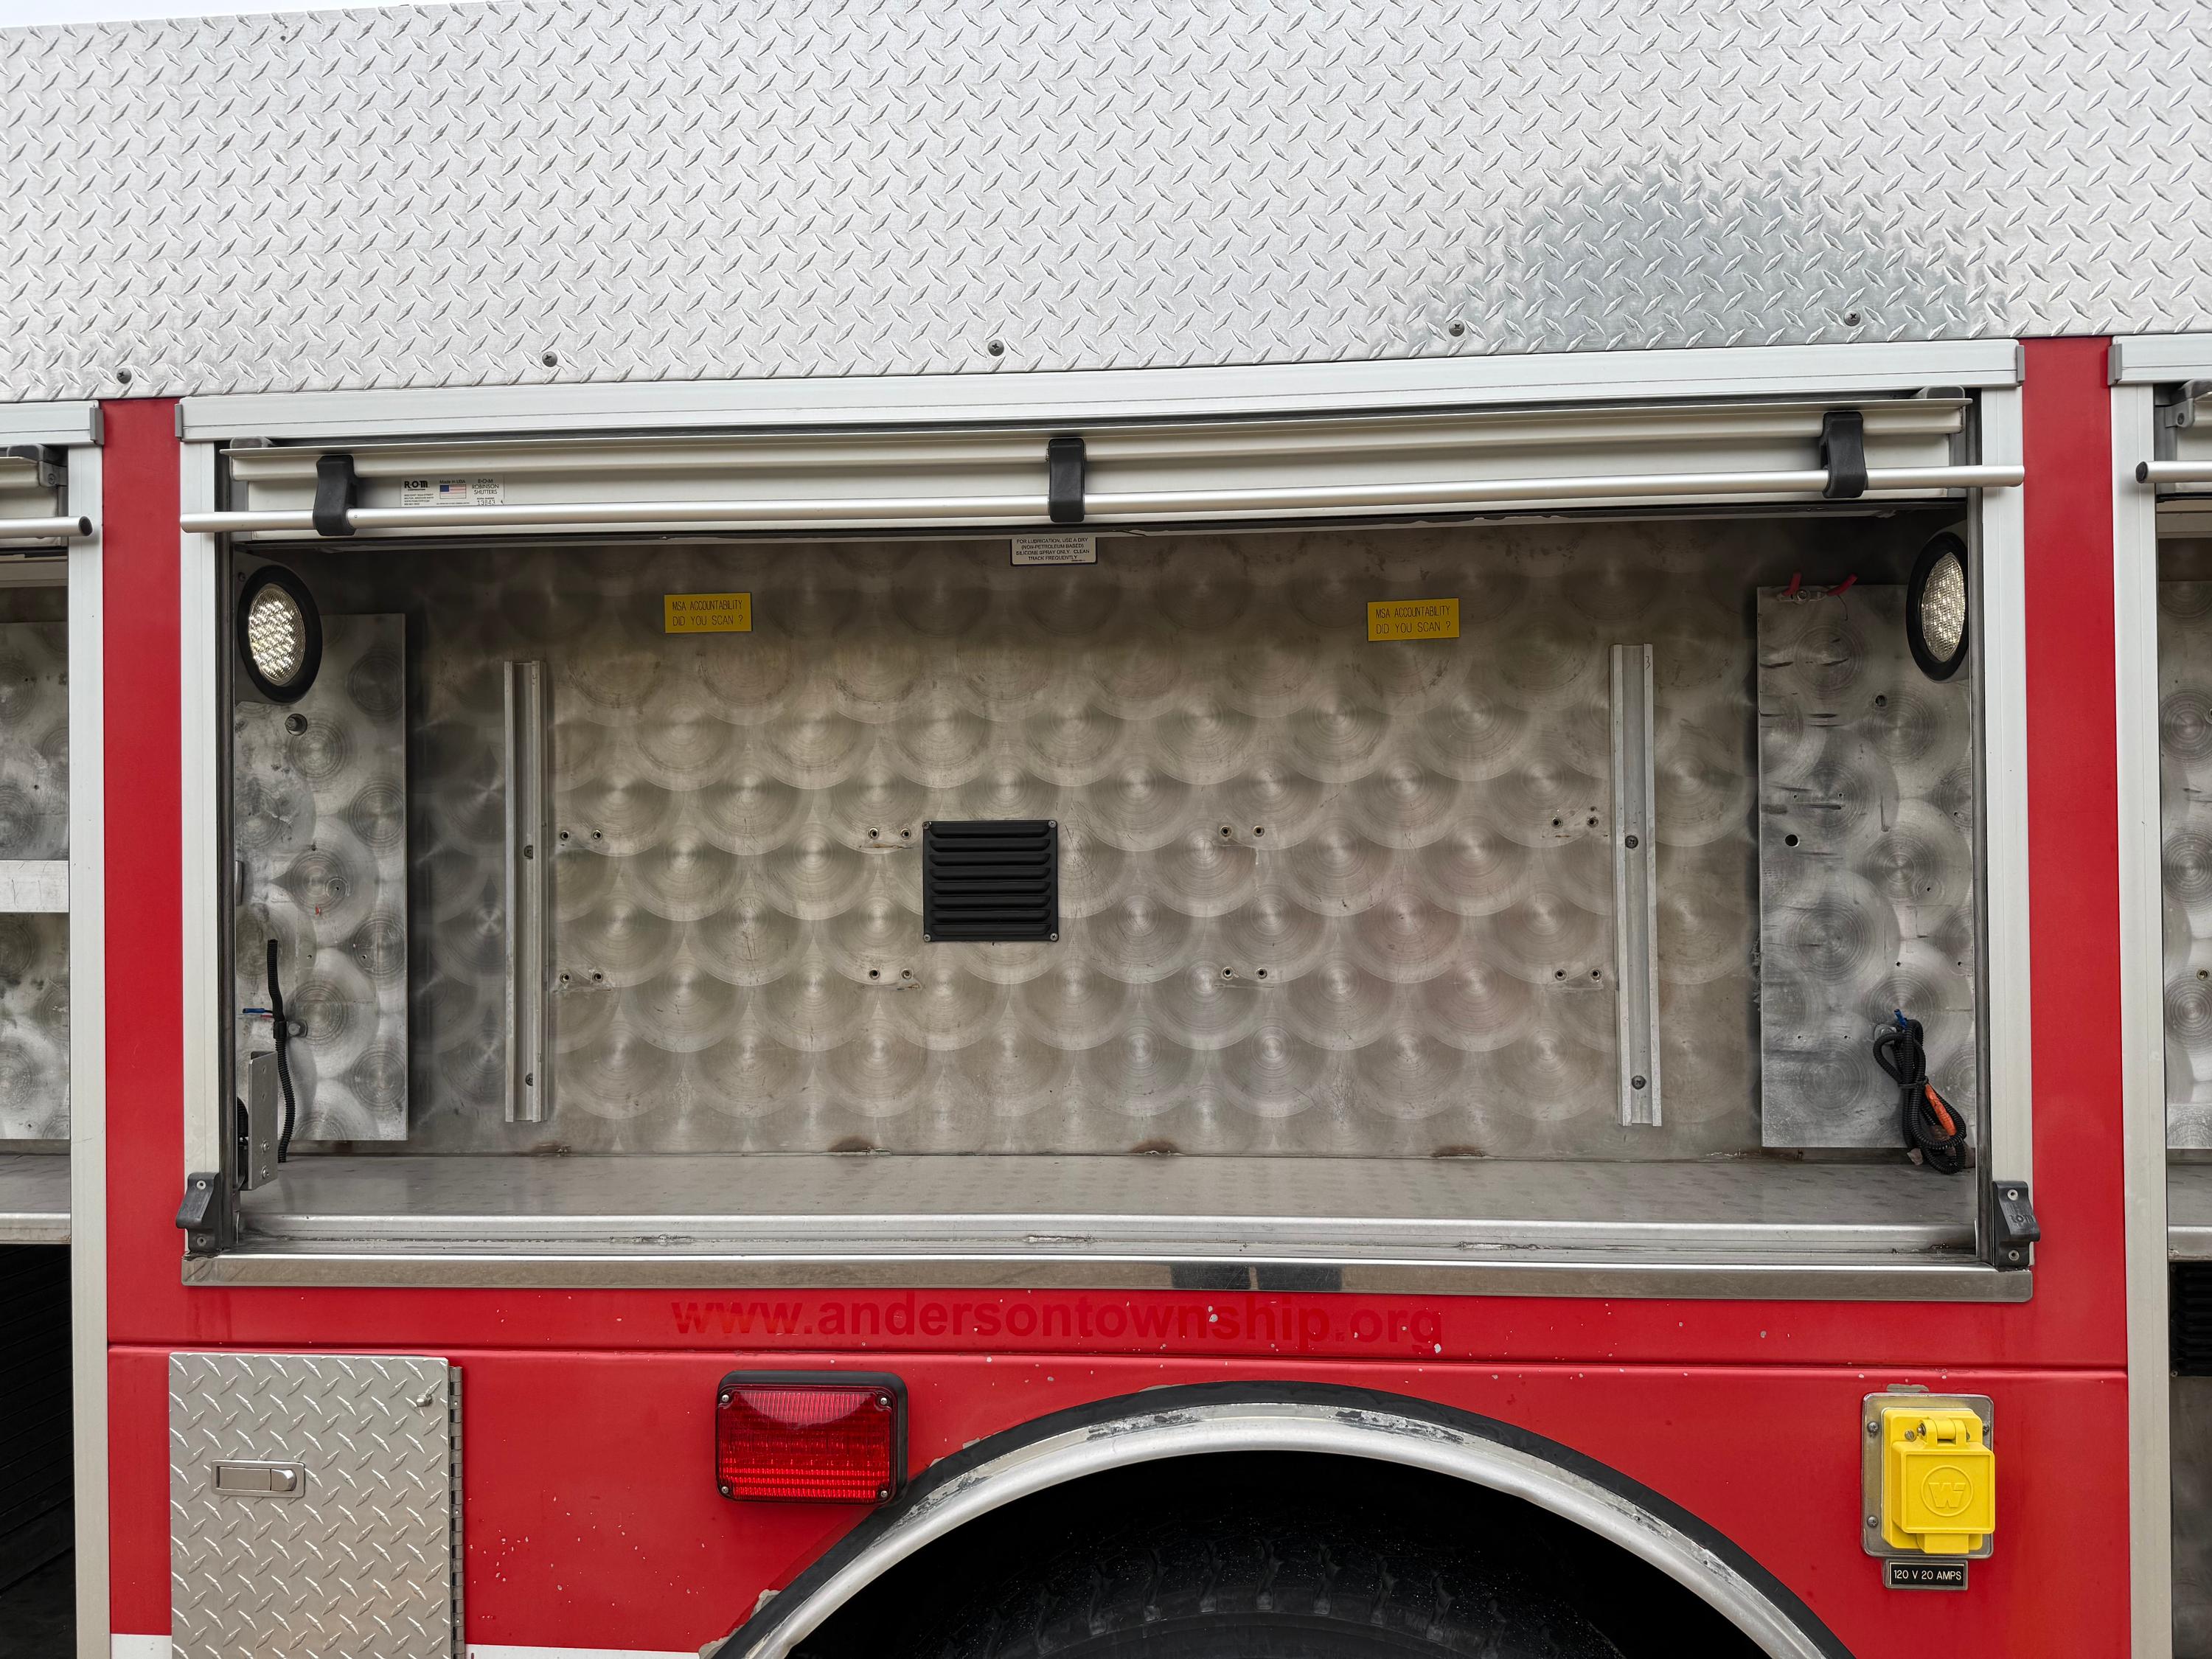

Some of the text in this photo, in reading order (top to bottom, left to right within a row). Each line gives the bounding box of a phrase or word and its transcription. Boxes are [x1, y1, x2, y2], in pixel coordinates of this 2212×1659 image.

[672, 599, 742, 611] MSA ACCOUNTABILITY
[1376, 605, 1450, 619] MSA ACCOUNTABILITY
[672, 614, 743, 626] DID YOU SCAN ?
[1376, 620, 1451, 634] DID YOU SCAN ?
[671, 1292, 1442, 1354] www.andersontownship.org
[1893, 1569, 1961, 1581] 120 V 20 AMPS
